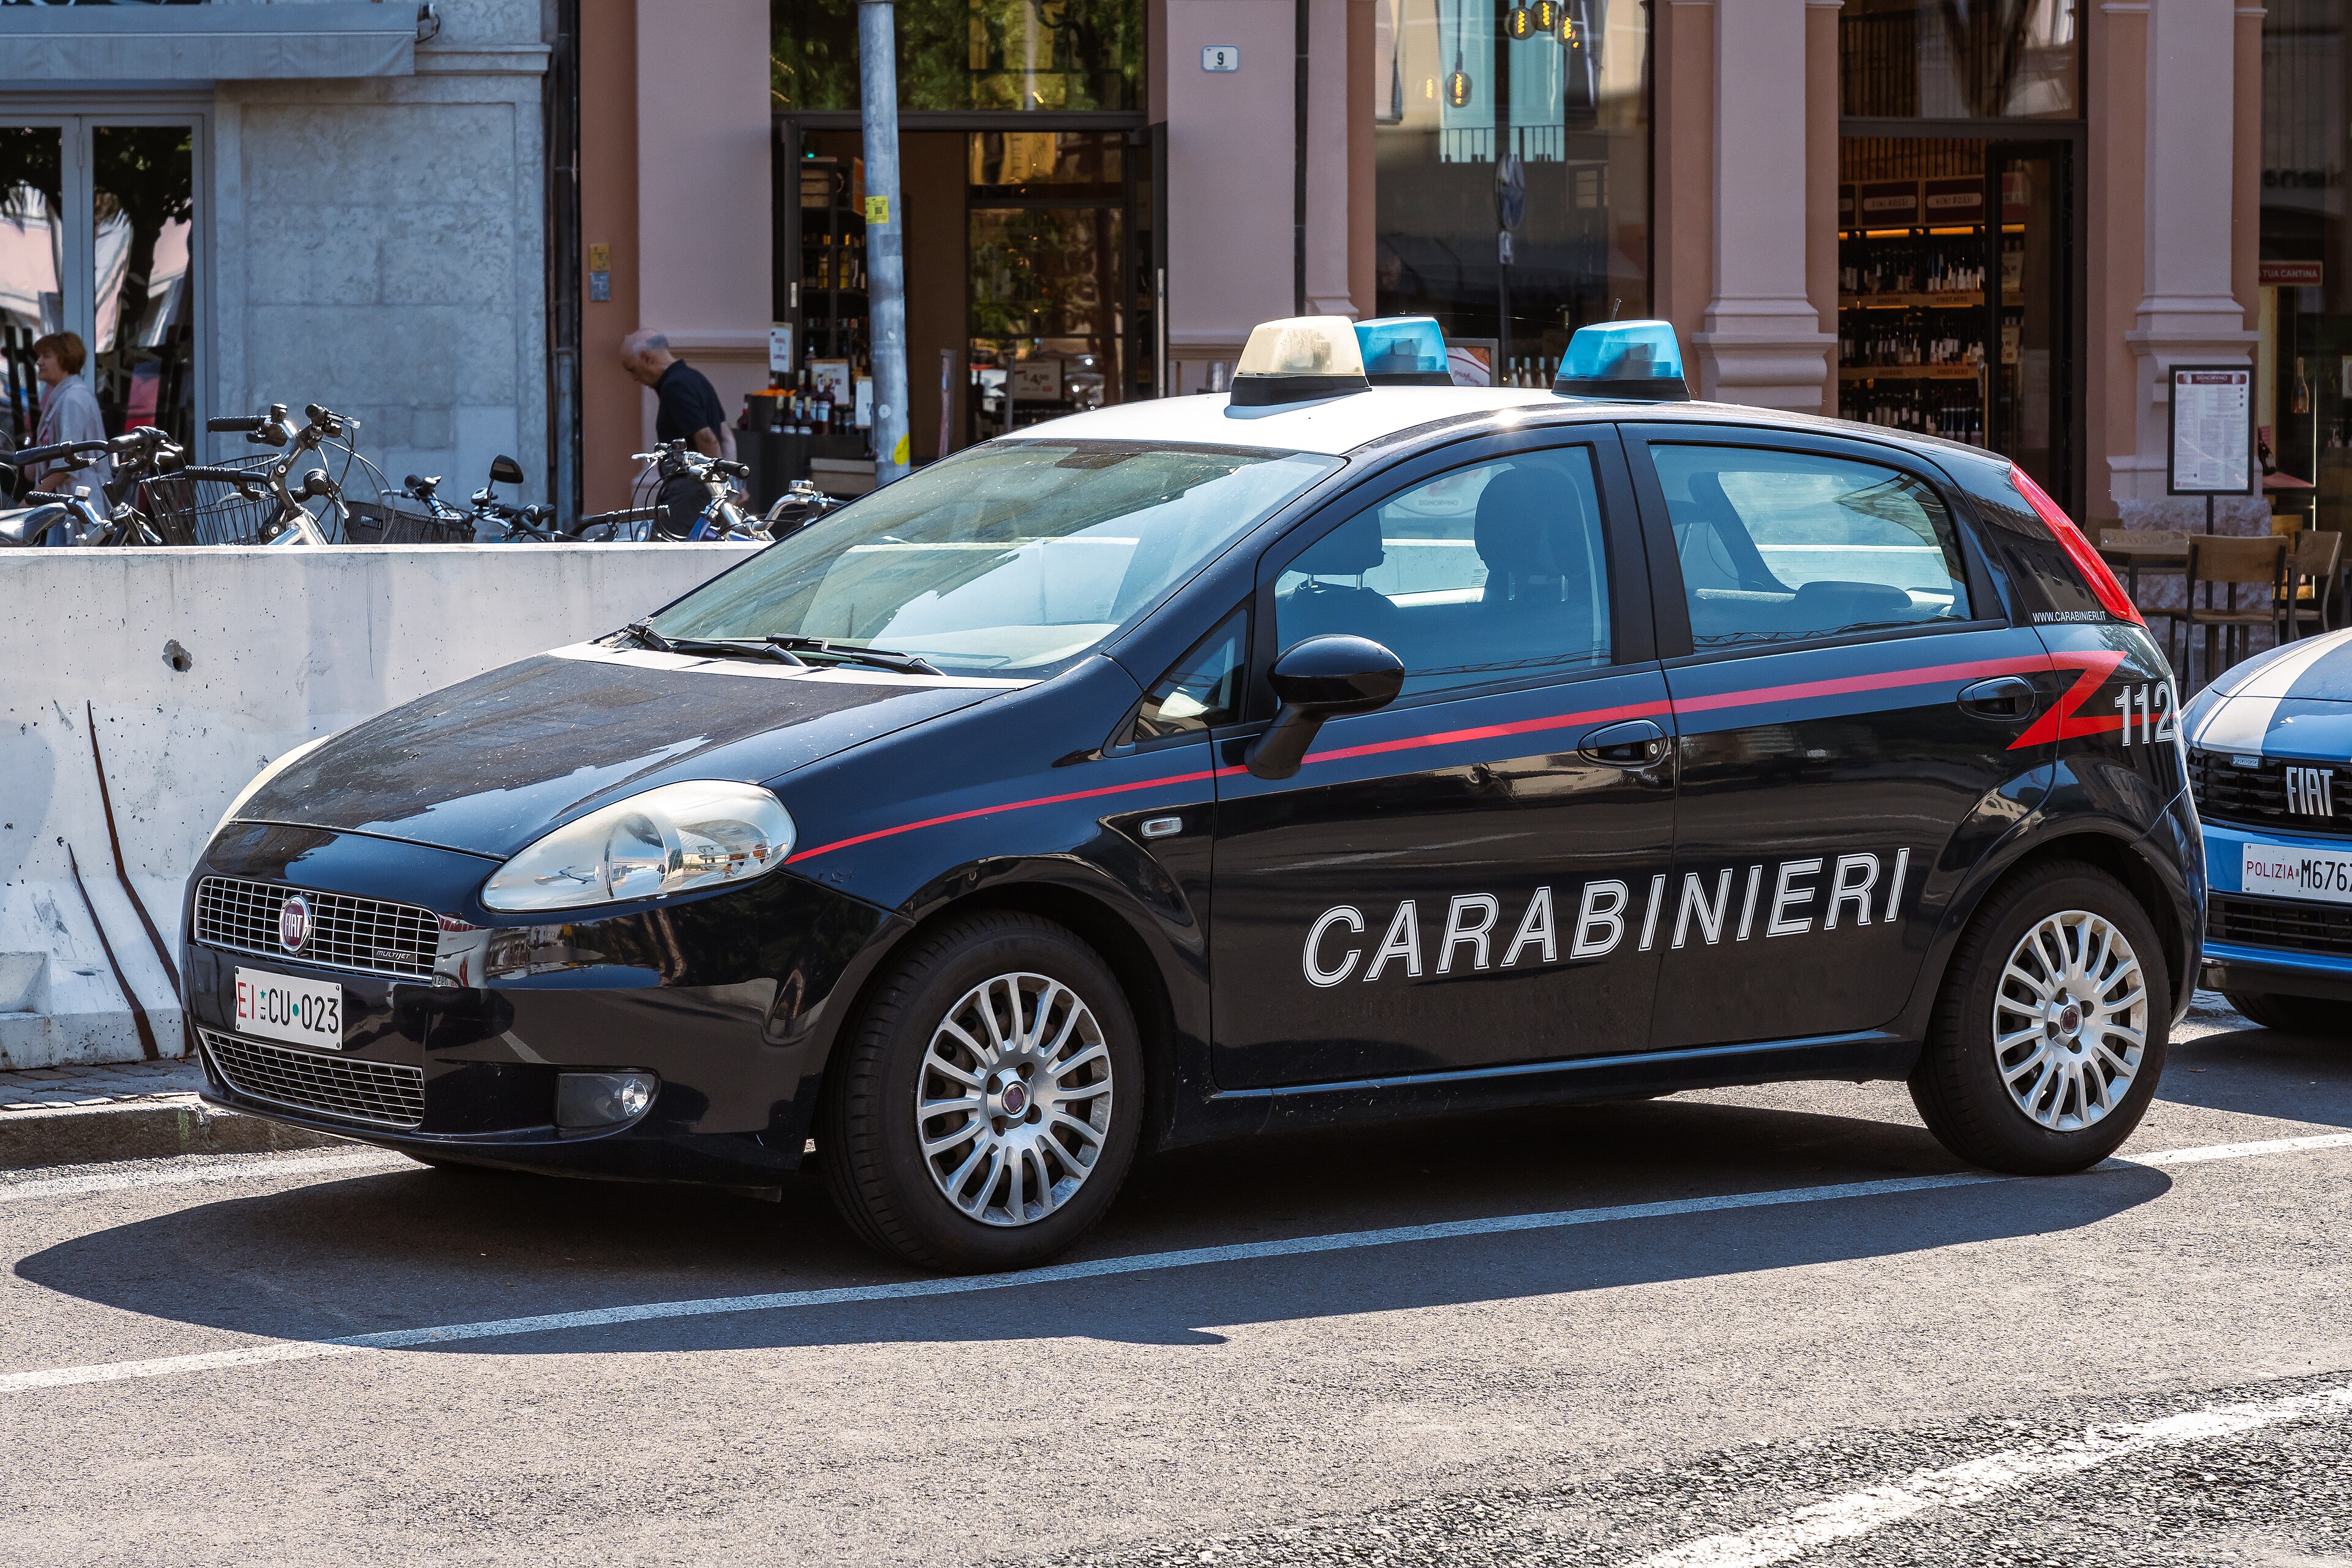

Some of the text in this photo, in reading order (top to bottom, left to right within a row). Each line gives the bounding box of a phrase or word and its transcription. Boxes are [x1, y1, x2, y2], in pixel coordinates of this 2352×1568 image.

[1217, 51, 1224, 65] 9
[2032, 611, 2106, 622] WWW.CARABINIERI.IT
[2115, 681, 2174, 746] 112
[2286, 767, 2333, 816] FIAT
[2247, 859, 2352, 892] POLIZIA M676
[285, 913, 303, 938] FIAT
[1303, 847, 1910, 987] CARABINIERI
[376, 950, 411, 960] MULTIJET
[238, 982, 255, 1020] EI
